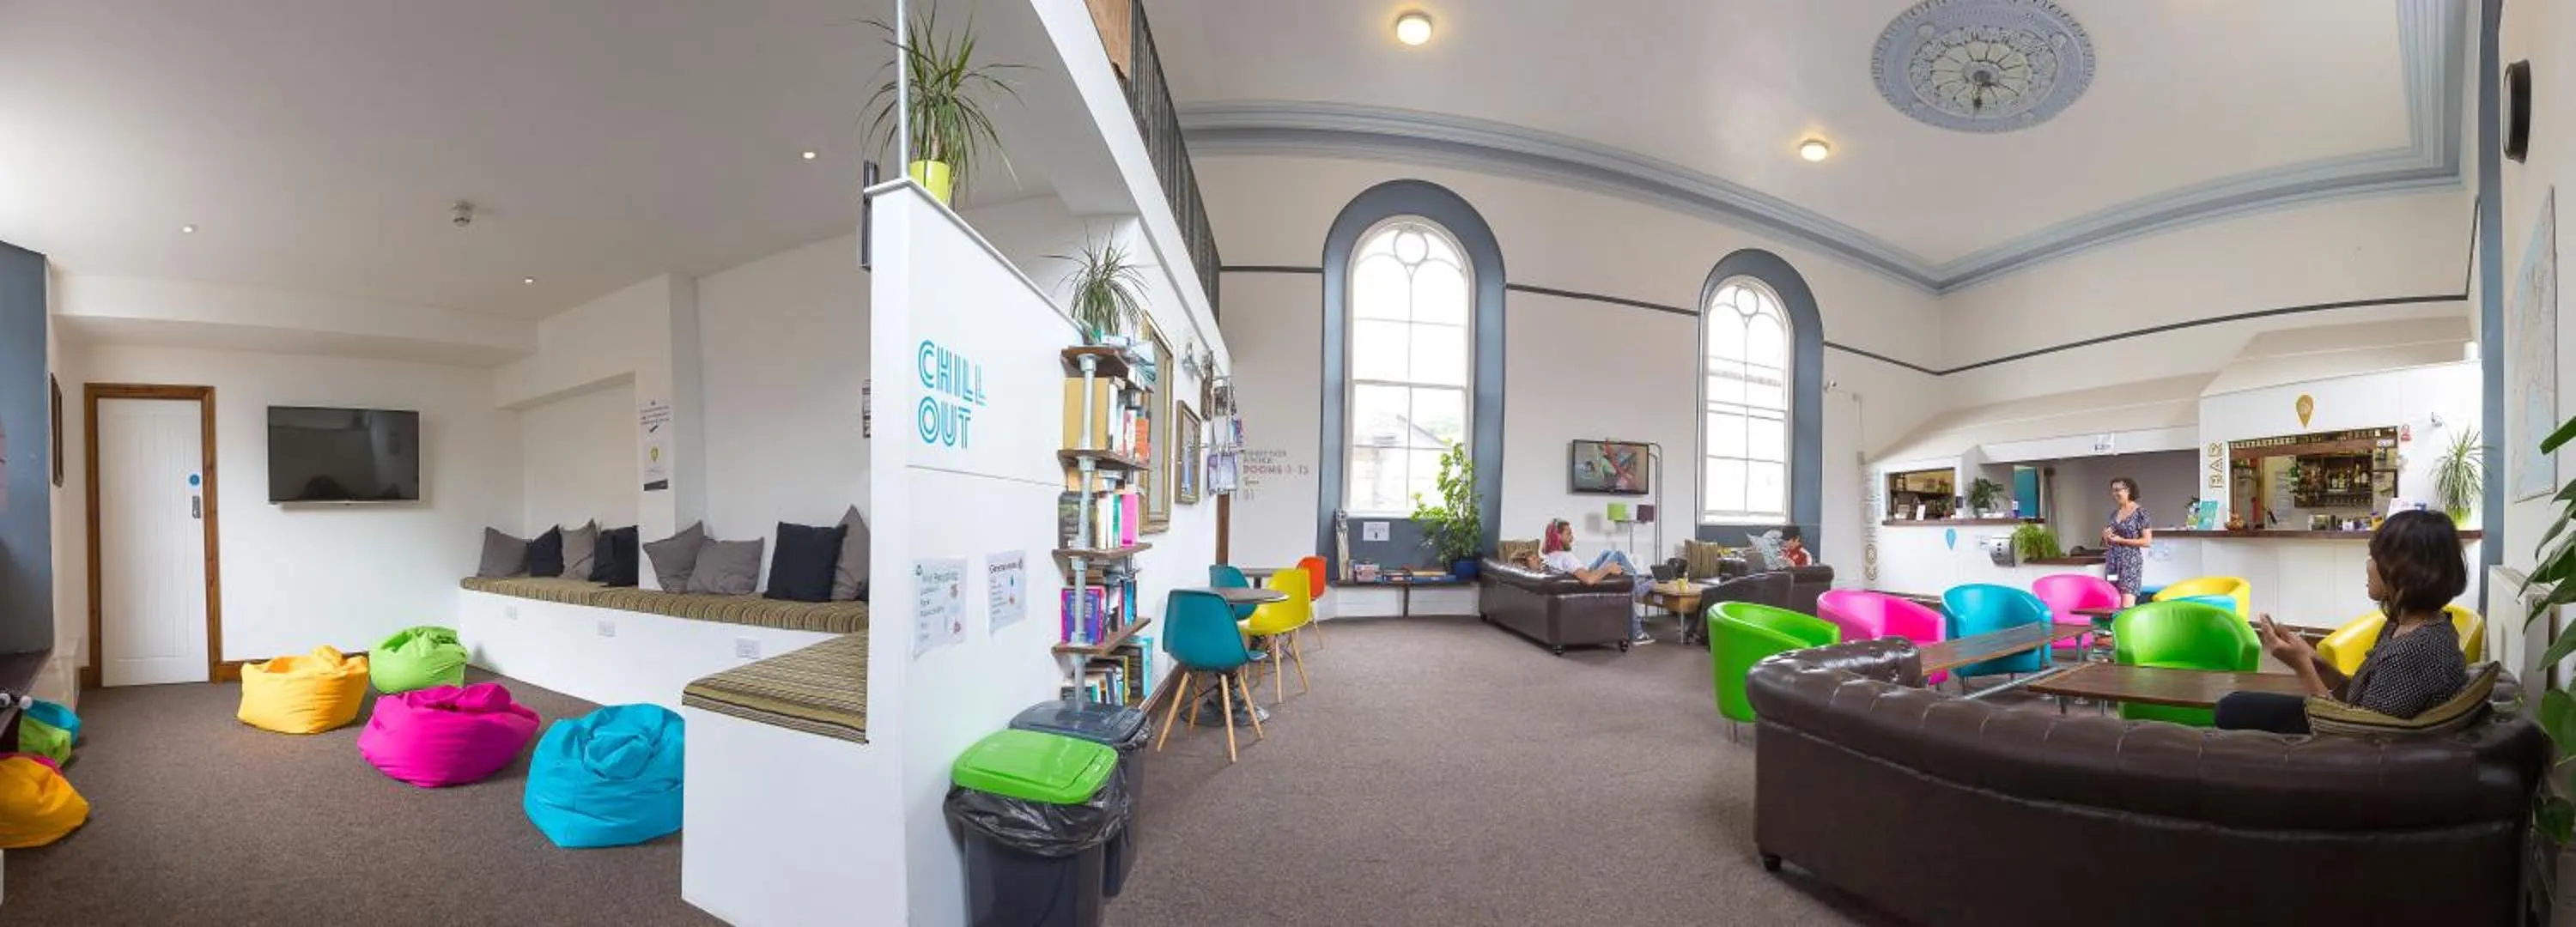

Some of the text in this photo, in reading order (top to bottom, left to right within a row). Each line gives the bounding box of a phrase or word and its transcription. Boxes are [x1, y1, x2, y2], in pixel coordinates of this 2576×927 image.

[918, 340, 987, 406] CHILL
[918, 397, 971, 449] OUT
[2208, 441, 2223, 488] BAR
